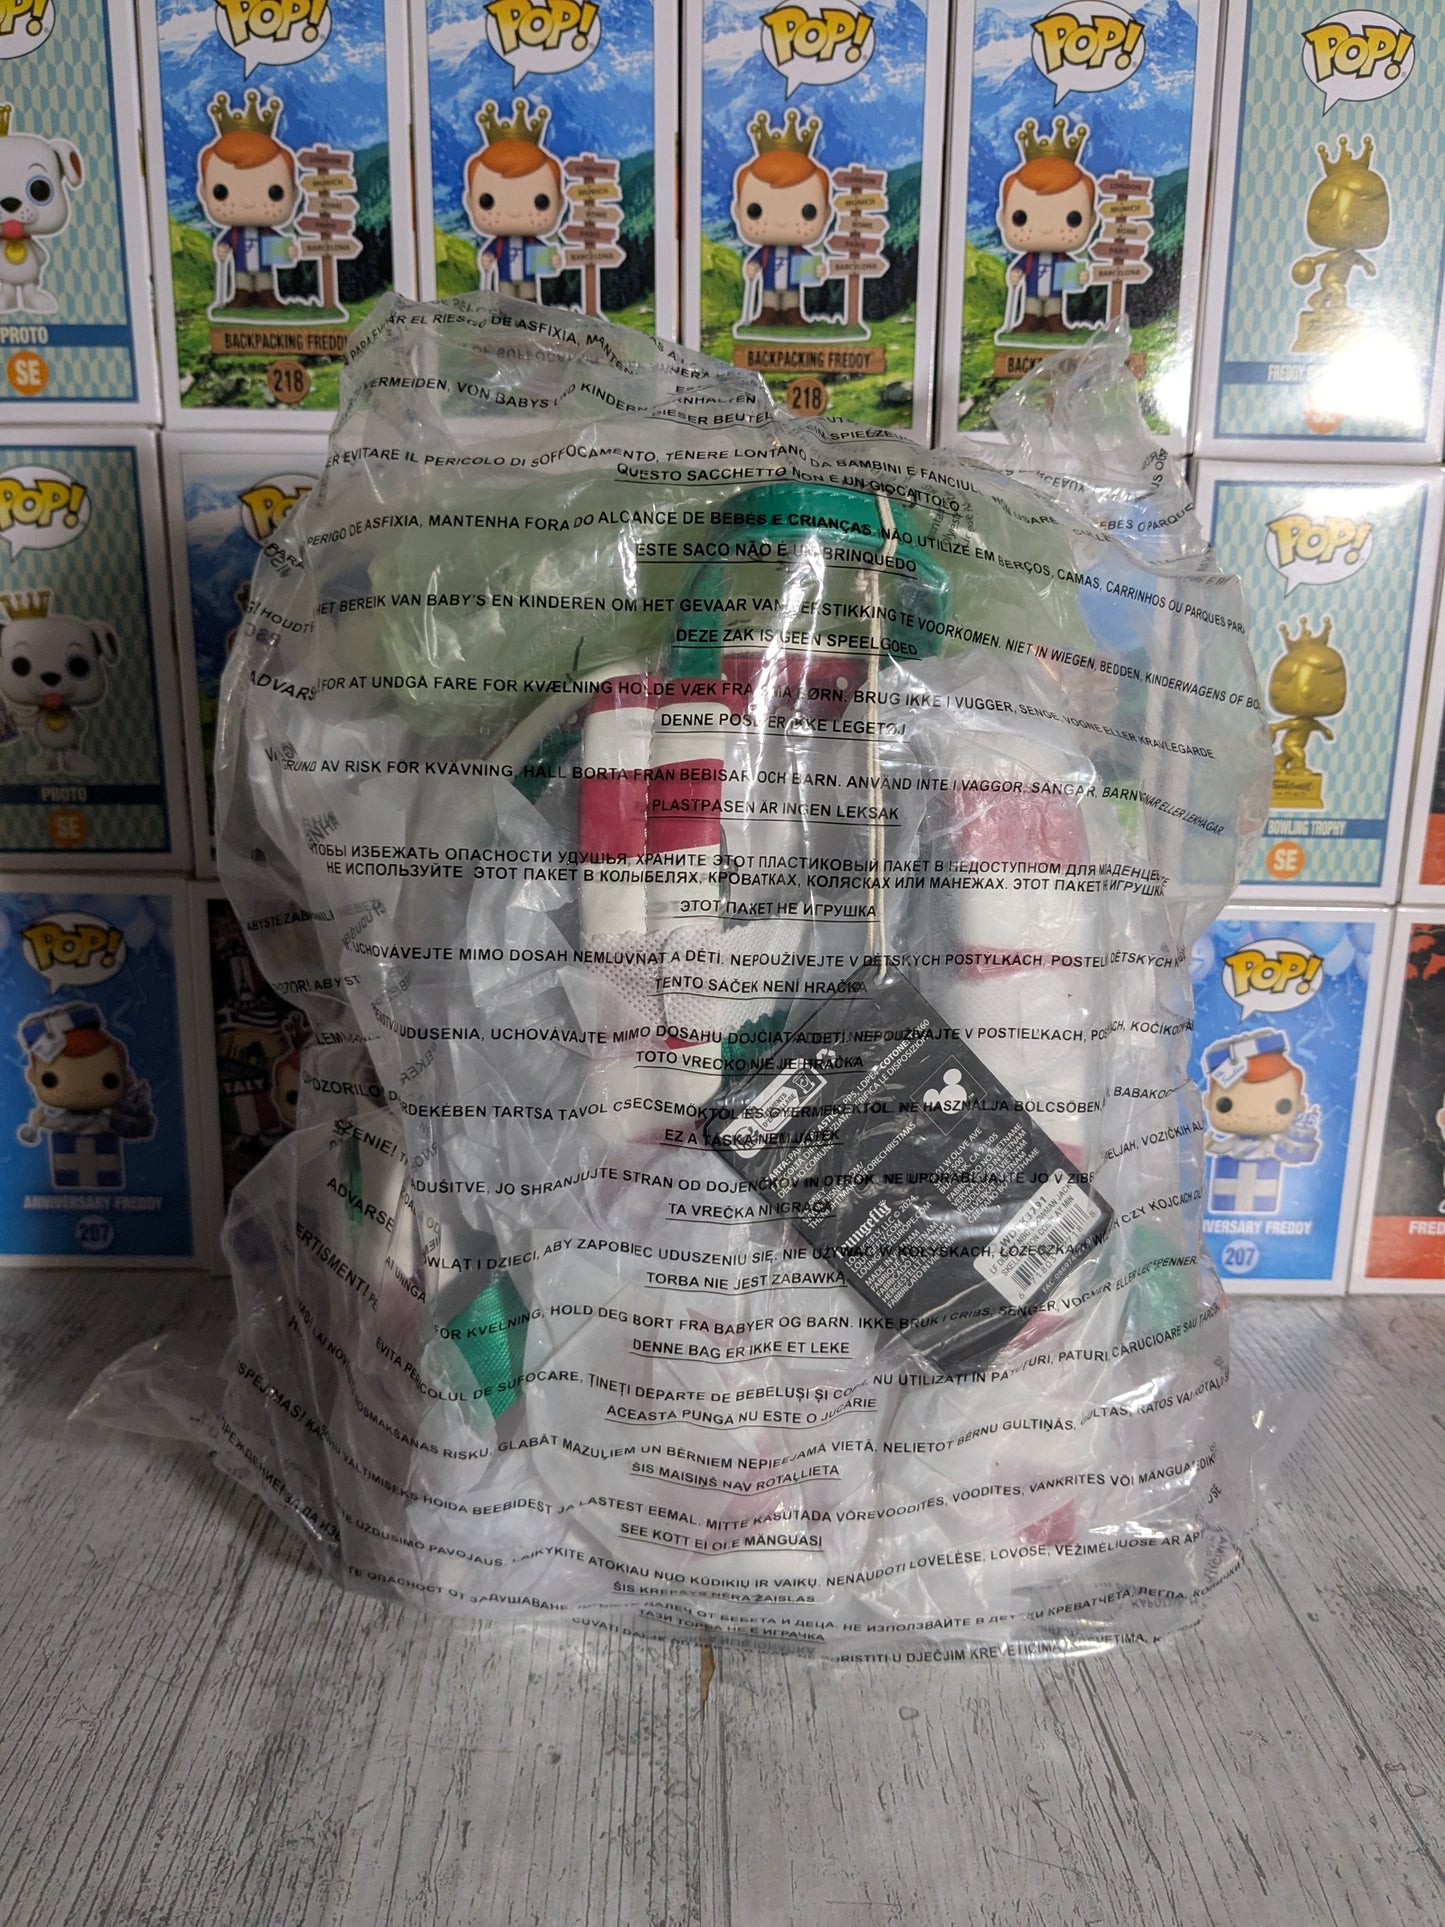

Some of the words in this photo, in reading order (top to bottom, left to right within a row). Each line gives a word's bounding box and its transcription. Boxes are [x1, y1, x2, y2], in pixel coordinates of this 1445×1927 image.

[217, 0, 329, 46] POP!
[493, 0, 595, 55] POP!
[761, 6, 874, 66] POP!
[1031, 12, 1143, 73] POP!
[1301, 23, 1415, 82] POP!
[1, 327, 48, 344] PROTO
[225, 332, 303, 350] BACKPACKING
[515, 320, 581, 345] ASFIXIA,
[748, 350, 824, 368] BACKPACKING
[828, 350, 872, 368] FREDDY
[14, 360, 41, 385] SE
[273, 369, 303, 393] 218
[364, 377, 450, 392] VERMEIDEN,
[495, 393, 548, 408] BABYS
[580, 383, 648, 413] KINDERN
[792, 386, 822, 410] 218
[714, 412, 772, 425] BEUTEL
[343, 448, 400, 462] EVITARE
[425, 455, 505, 467] PERICOLO
[531, 444, 660, 468] SOFFOCAMENTO,
[666, 448, 728, 461] TENERE
[734, 445, 806, 461] LONTANO
[836, 459, 901, 475] BAMBINI
[617, 463, 682, 481] QUESTO
[687, 467, 787, 481] SACCHETTO
[869, 479, 960, 512] GIOCATTOLO
[1266, 513, 1372, 567] POP!
[307, 530, 346, 546] PERIGO
[364, 515, 423, 532] ASFIXIA,
[429, 515, 520, 529] MANTENHA
[525, 517, 570, 532] FORA
[598, 510, 677, 525] ALCANCE
[917, 536, 971, 557] UTILIZE
[998, 555, 1054, 579] BERÇOS,
[1057, 568, 1102, 590] CAMAS,
[1106, 581, 1166, 608] CARRINHOS
[1185, 604, 1225, 628] PARQUES
[636, 542, 677, 556] ESTE
[683, 543, 730, 557] SACO
[823, 545, 916, 572] BRINQUEDO
[340, 595, 385, 611] BEREIK
[428, 593, 486, 607] BABY'S
[519, 595, 606, 612] KINDEREN
[680, 599, 746, 612] GEVAAR
[1050, 649, 1097, 672] WIEGEN,
[1099, 660, 1143, 682] BEDDEN,
[1145, 672, 1226, 702] KINDERWAGENS
[676, 628, 718, 642] DEZE
[826, 633, 917, 656] SPEELGOED
[434, 677, 477, 691] FARE
[523, 680, 613, 695] KVÆLNING
[955, 697, 1017, 715] VUGGER,
[661, 713, 713, 727] DENNE
[832, 719, 906, 736] LEGETØJ
[346, 760, 381, 773] RISK
[425, 760, 517, 778] KVÄVNING,
[572, 766, 627, 781] BORTA
[846, 774, 912, 791] ANVÄND
[961, 780, 1026, 794] VAGGOR,
[42, 787, 87, 801] PROTO
[782, 802, 831, 817] INGEN
[836, 805, 899, 820] LEKSAK
[1267, 820, 1309, 835] BOWLING
[1311, 821, 1346, 835] TROPHY
[351, 845, 439, 860] ИЗБЕЖАТЬ
[445, 847, 551, 863] ОПАСНОСТИ
[637, 852, 706, 867] ХРАНИТЕ
[713, 854, 754, 869] ЭТОТ
[759, 855, 879, 872] ПЛАСТИКОВЫЙ
[949, 861, 1061, 875] НЕДОСТУПНОМ
[1273, 849, 1297, 871] SE
[346, 859, 463, 879] ИСПОЛЬЗУЙТЕ
[524, 869, 578, 882] ПАКЕТ
[600, 869, 702, 885] КОЛЫБЕЛЯХ,
[708, 871, 800, 888] КРОВАТКАХ,
[807, 875, 890, 890] КОЛЯСКАХ
[929, 878, 1008, 890] МАНЕЖАХ.
[802, 903, 876, 918] ИГРУШКА
[20, 923, 124, 972] POP!
[353, 942, 453, 960] UCHOVÁVEJTE
[459, 949, 504, 962] MIMO
[509, 948, 567, 963] DOSAH
[731, 951, 844, 968] NEPOUŽÍVEJTE
[1224, 949, 1324, 996] POP!
[655, 977, 703, 990] TENTO
[708, 977, 759, 993] SÁČEK
[763, 978, 799, 993] NENÍ
[491, 1026, 607, 1044] UCHOVÁVAJTE
[656, 1025, 722, 1043] DOSAHU
[636, 1051, 677, 1063] TOTO
[682, 1054, 746, 1071] VRECKO
[493, 1105, 553, 1120] TARTSA
[950, 1139, 970, 1159] OLIVE
[969, 1126, 982, 1142] AVE
[952, 1157, 964, 1171] 500
[521, 1167, 617, 1196] SHRANJUJTE
[623, 1170, 673, 1189] STRAN
[707, 1177, 799, 1194] DOJENČKOV
[691, 1205, 754, 1219] VREČKA
[882, 1216, 895, 1231] LLC
[78, 1225, 109, 1242] 207
[1203, 1219, 1259, 1234] IVERSARY
[1265, 1220, 1312, 1235] FREDDY
[1409, 1221, 1445, 1235] FRED
[487, 1249, 540, 1270] DZIECI,
[658, 1248, 747, 1266] UDUSZENIU
[1226, 1248, 1255, 1265] 207
[647, 1272, 700, 1288] TORBA
[733, 1275, 767, 1291] JEST
[865, 1267, 886, 1286] MADE
[876, 1261, 912, 1298] FABRICADO
[887, 1271, 923, 1309] FABBRICATO
[467, 1308, 545, 1338] KVELNING,
[633, 1314, 674, 1329] BORT
[714, 1318, 774, 1335] BABYER
[806, 1317, 853, 1328] BARN.
[859, 1317, 894, 1329] IKKE
[633, 1338, 684, 1355] DENNE
[810, 1341, 850, 1354] LEKE
[498, 1370, 584, 1392] SUFOCARE,
[635, 1386, 706, 1402] DEPARTE
[763, 1410, 801, 1424] ESTE
[443, 1447, 493, 1460] RISKU.
[472, 1497, 553, 1515] BEEBIDEST
[648, 1505, 701, 1527] EEMAL.
[753, 1509, 832, 1525] KASUTADA
[1029, 1473, 1106, 1493] VANKRITES
[653, 1529, 690, 1547] KOTT
[744, 1534, 822, 1547] MÄNGUASI
[826, 1563, 906, 1587] NENAUDOTI
[990, 1544, 1050, 1560] LOVOSE,
